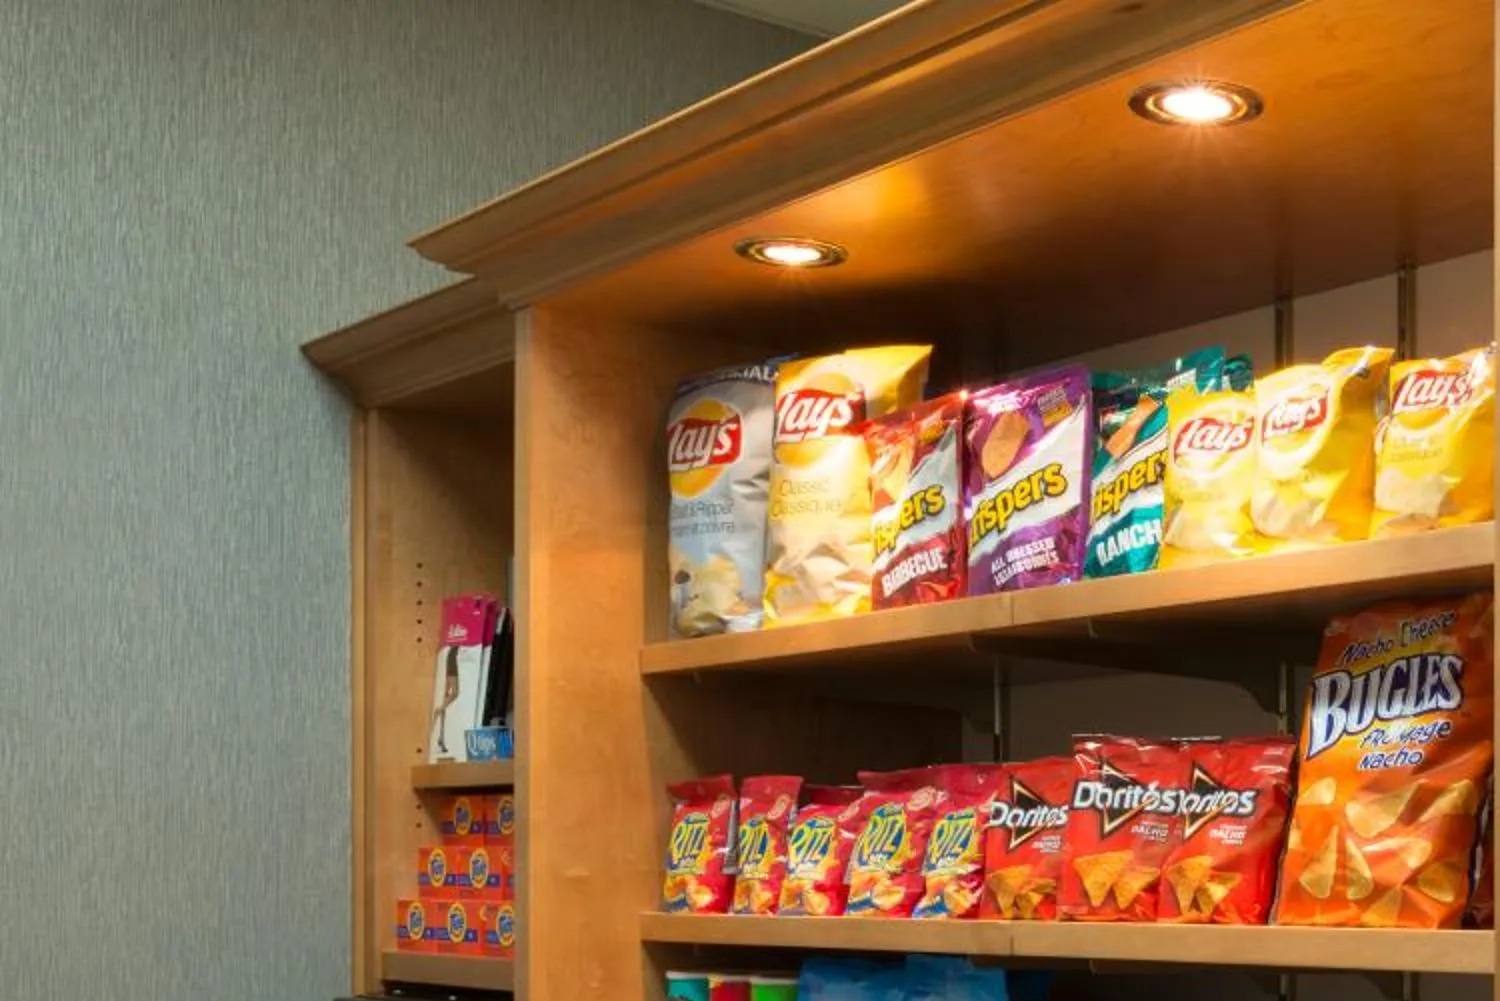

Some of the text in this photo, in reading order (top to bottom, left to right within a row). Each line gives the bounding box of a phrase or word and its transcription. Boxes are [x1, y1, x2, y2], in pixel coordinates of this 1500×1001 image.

[1393, 371, 1472, 413] Lay's
[776, 393, 854, 443] Lay's
[969, 461, 1069, 547] rispers
[1096, 519, 1161, 566] RANCH
[881, 548, 948, 598] BARBECUE
[1400, 610, 1457, 645] Cheese
[1305, 653, 1464, 761] BUGLES
[988, 801, 1070, 828] Doritos
[1073, 781, 1181, 814] Doritos
